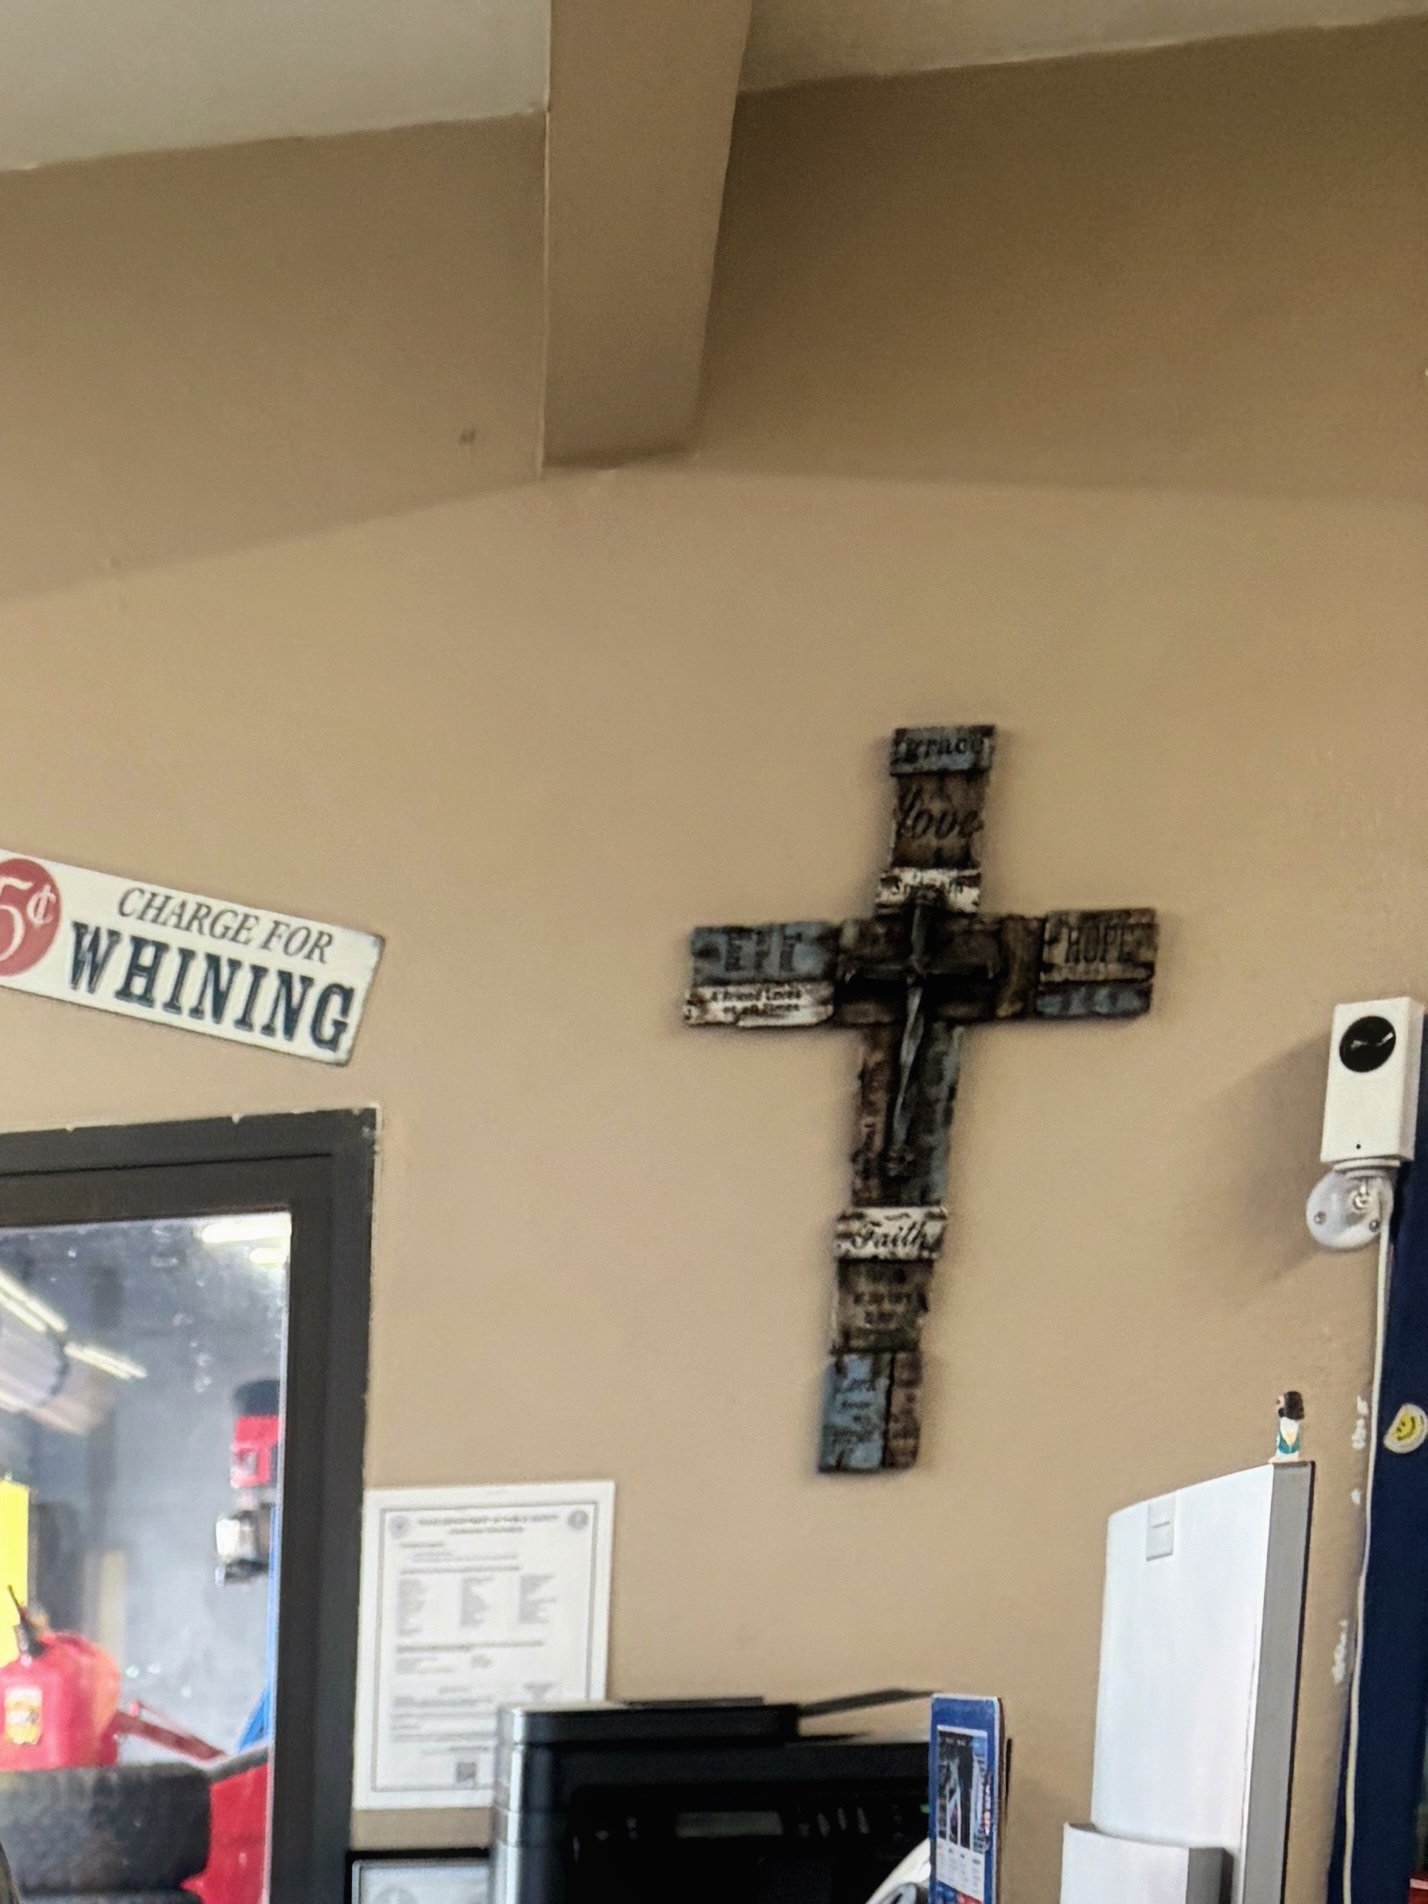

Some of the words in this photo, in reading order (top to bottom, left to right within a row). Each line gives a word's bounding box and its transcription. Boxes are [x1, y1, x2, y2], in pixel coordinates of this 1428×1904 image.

[117, 886, 259, 946] CHARGE
[258, 919, 333, 964] FOR
[68, 920, 354, 1053] WHINING
